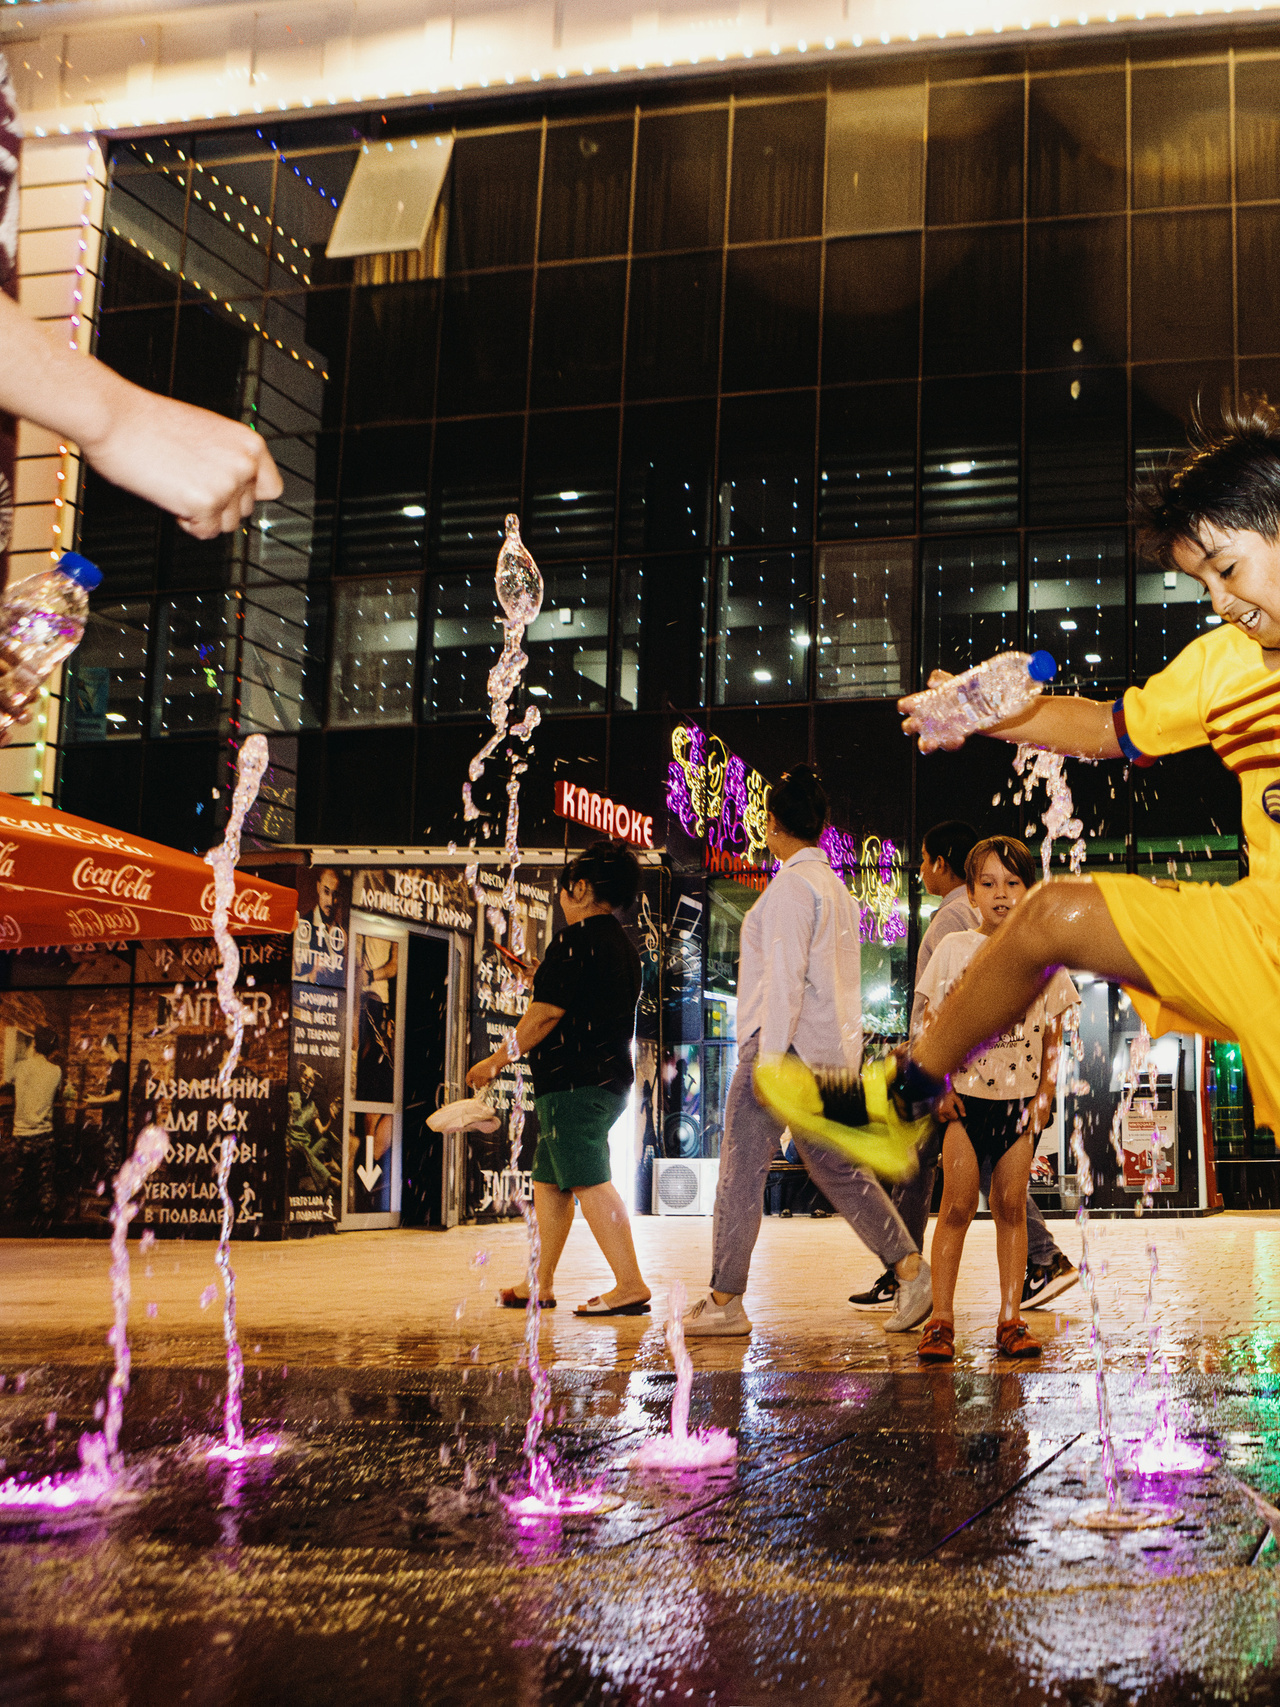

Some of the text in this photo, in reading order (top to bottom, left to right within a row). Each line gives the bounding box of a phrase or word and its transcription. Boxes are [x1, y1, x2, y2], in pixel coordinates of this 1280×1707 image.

[562, 780, 653, 849] KARAOKE
[0, 815, 153, 858] ca-Cola
[72, 857, 155, 900] Coca-Cola
[394, 870, 444, 905] КВЕСТЫ
[426, 902, 435, 921] И
[182, 944, 275, 967] КОМТЫ?
[145, 1078, 270, 1099] РАЗВЛЕЧЕНИЯ
[164, 1110, 249, 1132] ДЛЯ ВСЕХ
[164, 1142, 258, 1164] ОЗРАСОВ!
[144, 1181, 223, 1200] YERTO'LAD
[145, 1208, 226, 1224] В ПОДВАЛЕ
